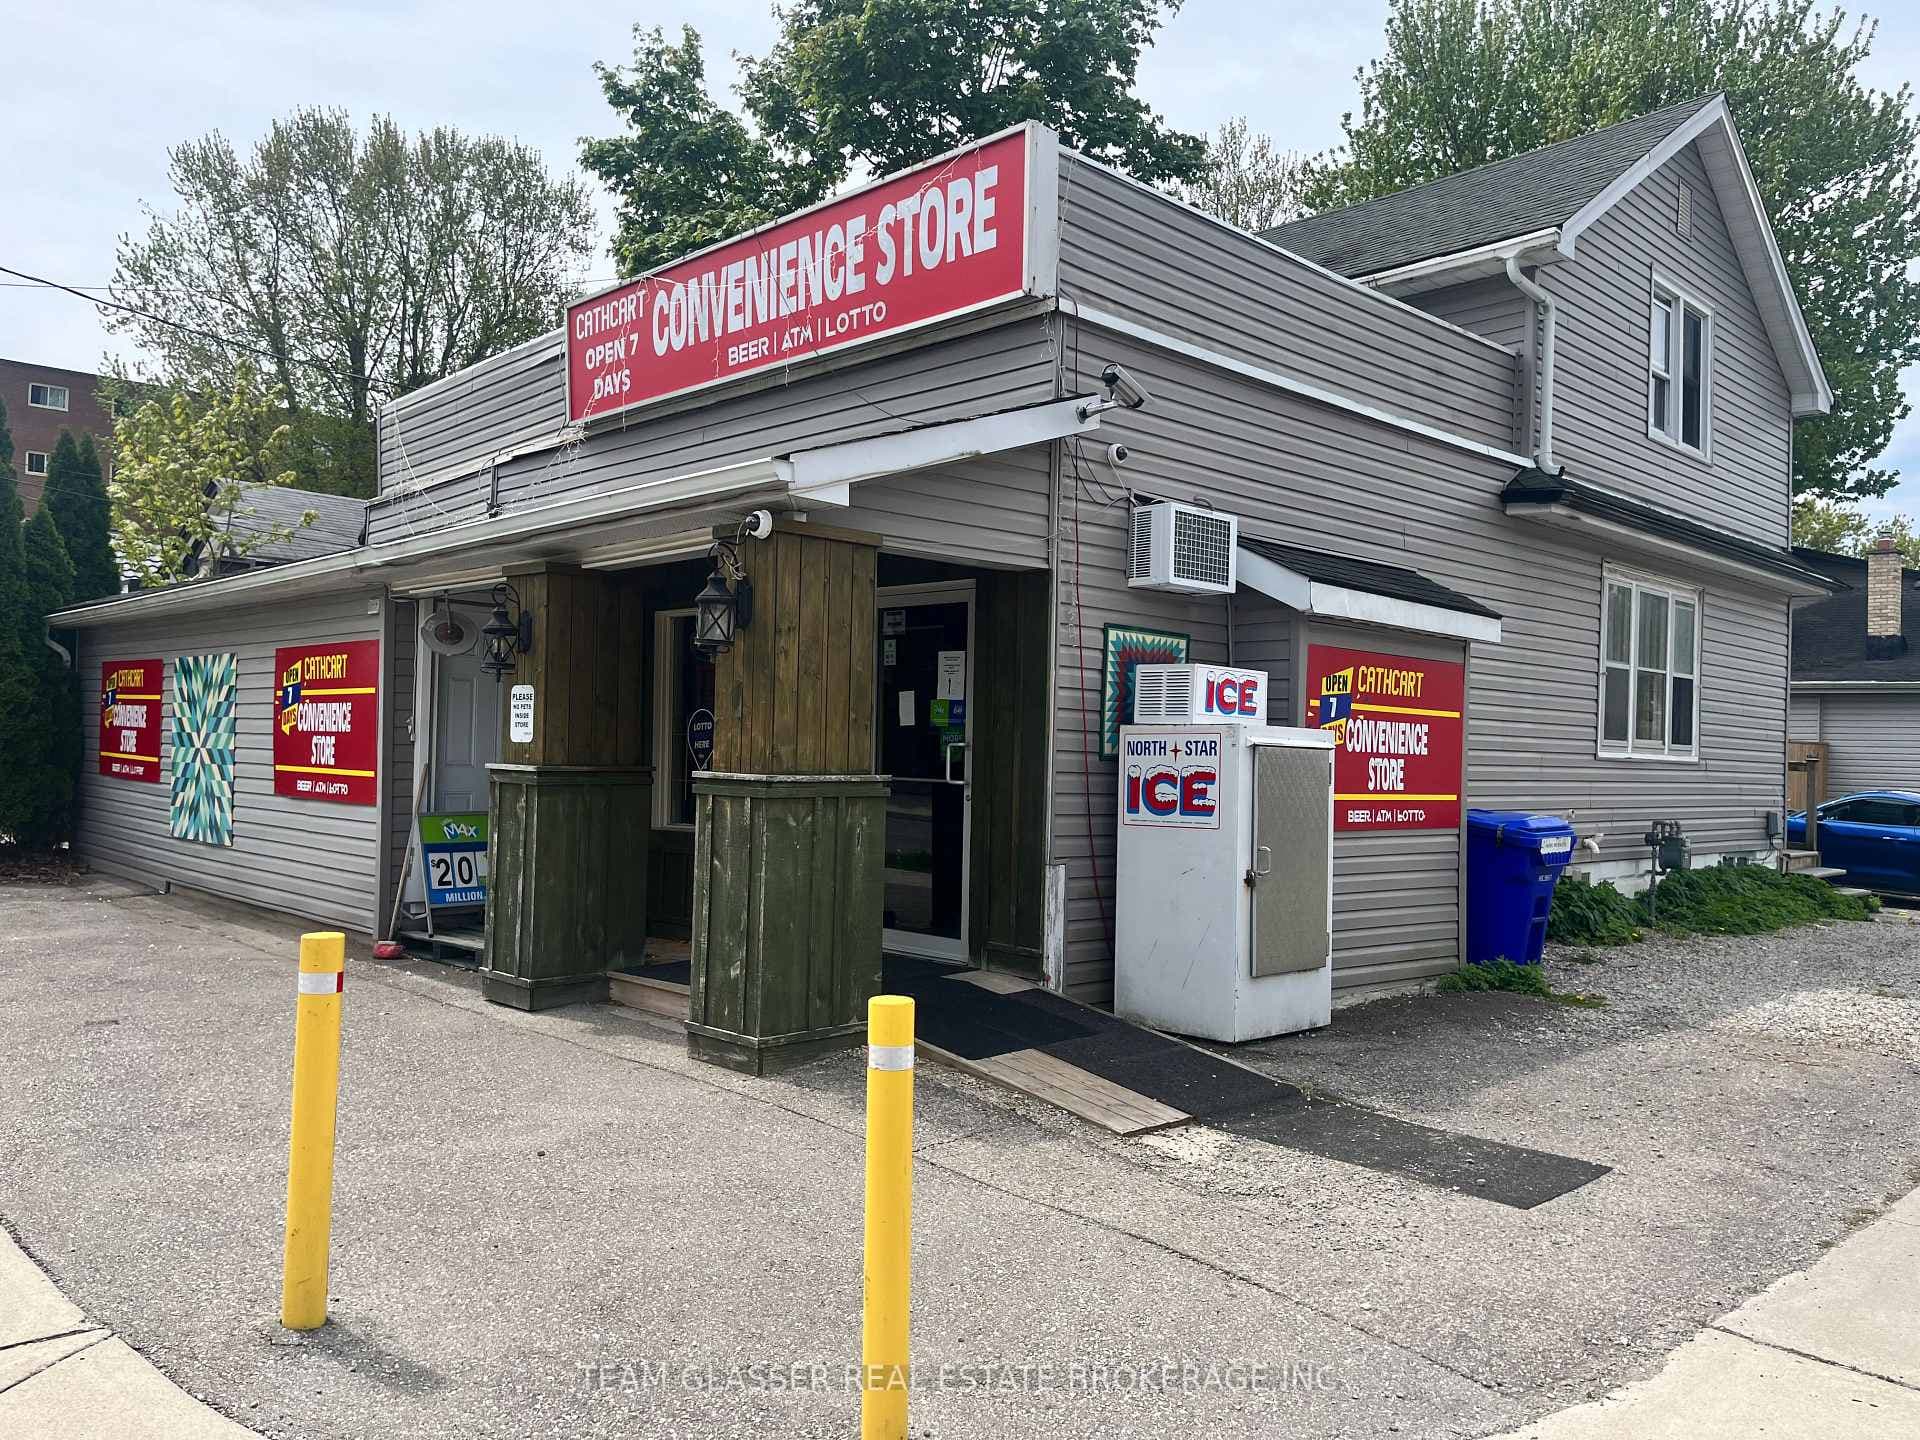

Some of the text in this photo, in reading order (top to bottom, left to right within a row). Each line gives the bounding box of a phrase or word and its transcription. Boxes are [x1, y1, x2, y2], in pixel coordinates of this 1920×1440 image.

[652, 165, 998, 356] CONVENIENCE STORE
[576, 290, 647, 340] CATHCART
[728, 301, 886, 366] BEER ATM LOTTO
[585, 332, 639, 370] OPEN 7
[593, 368, 631, 400] DAYS
[304, 654, 348, 680] CATHCART
[1325, 674, 1348, 692] OPEN
[1358, 665, 1425, 698] CATHCART
[288, 686, 293, 704] 7
[1204, 671, 1259, 716] ICE
[1329, 697, 1337, 718] 7
[297, 702, 352, 732] CONVENIENCE
[311, 735, 336, 766] STORE
[1127, 740, 1218, 756] NORTH STAR
[1346, 719, 1428, 755] CONVENIENCE
[1368, 757, 1404, 791] STORE
[1126, 764, 1217, 817] ICE
[1348, 810, 1426, 823] BEER ATM LOTTO
[445, 891, 483, 903] MILLION
